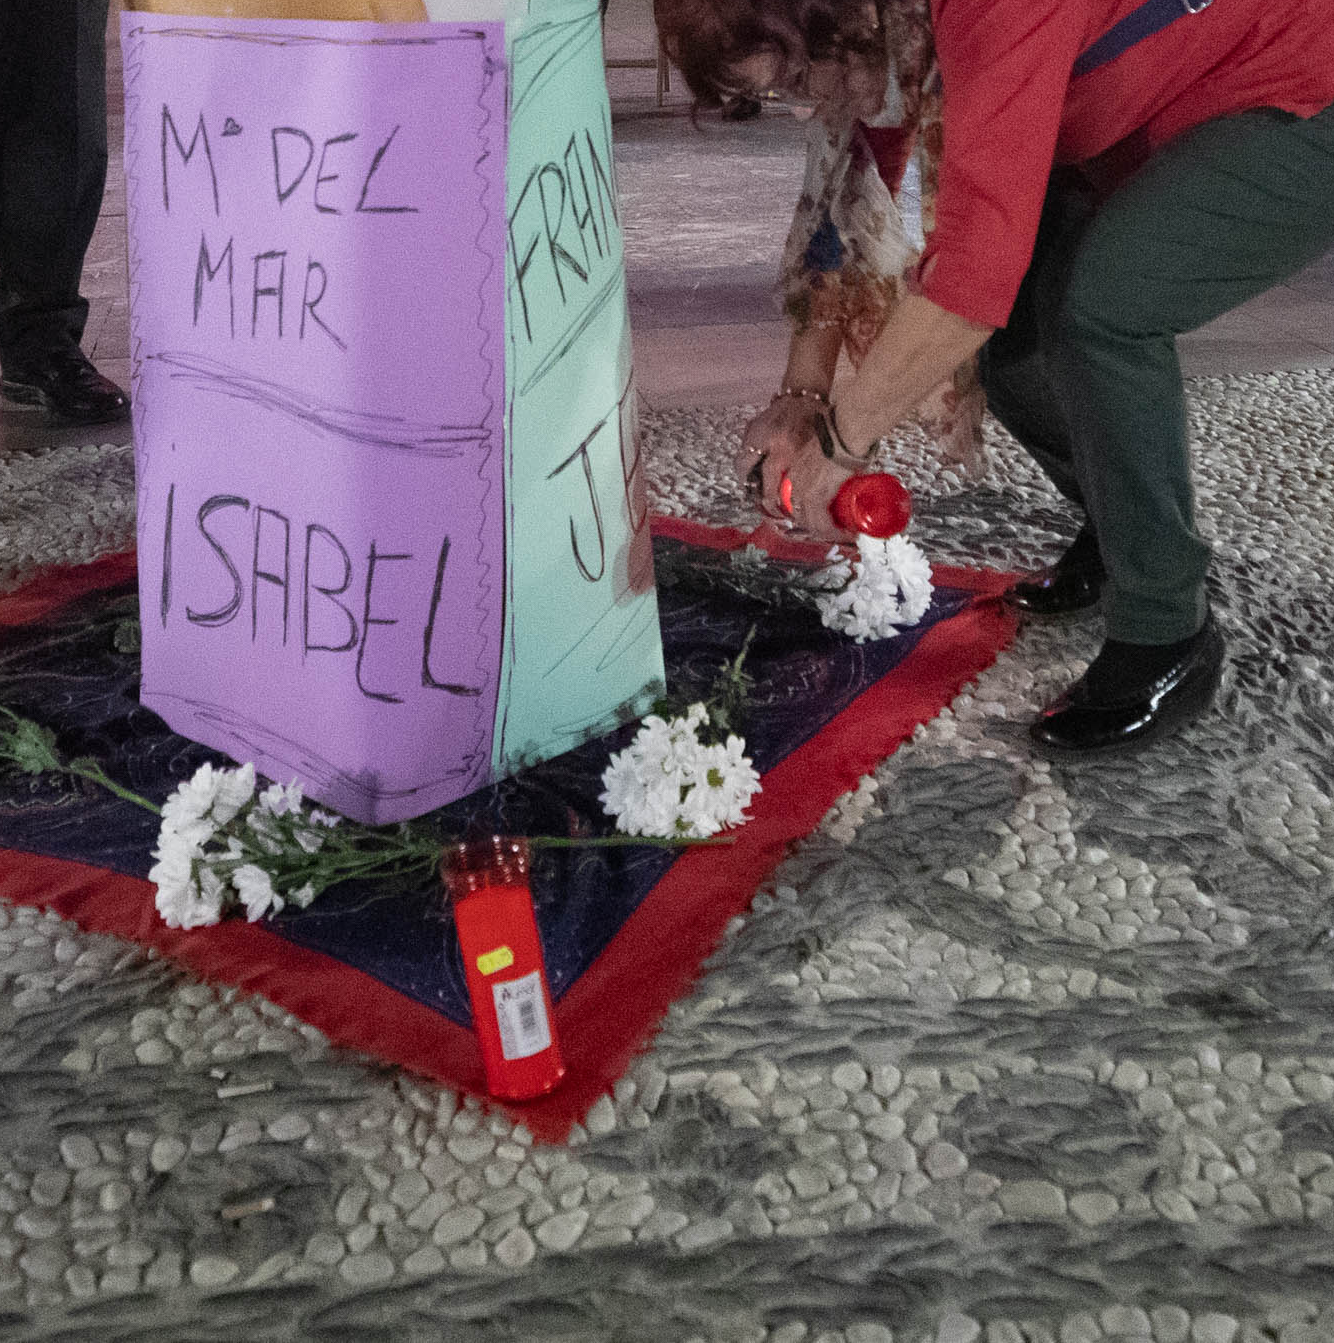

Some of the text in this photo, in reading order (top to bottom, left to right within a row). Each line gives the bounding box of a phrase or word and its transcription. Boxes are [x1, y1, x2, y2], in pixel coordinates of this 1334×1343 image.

[271, 124, 420, 216] DEL
[192, 229, 349, 352] MAR
[160, 482, 484, 705] ISABEL
